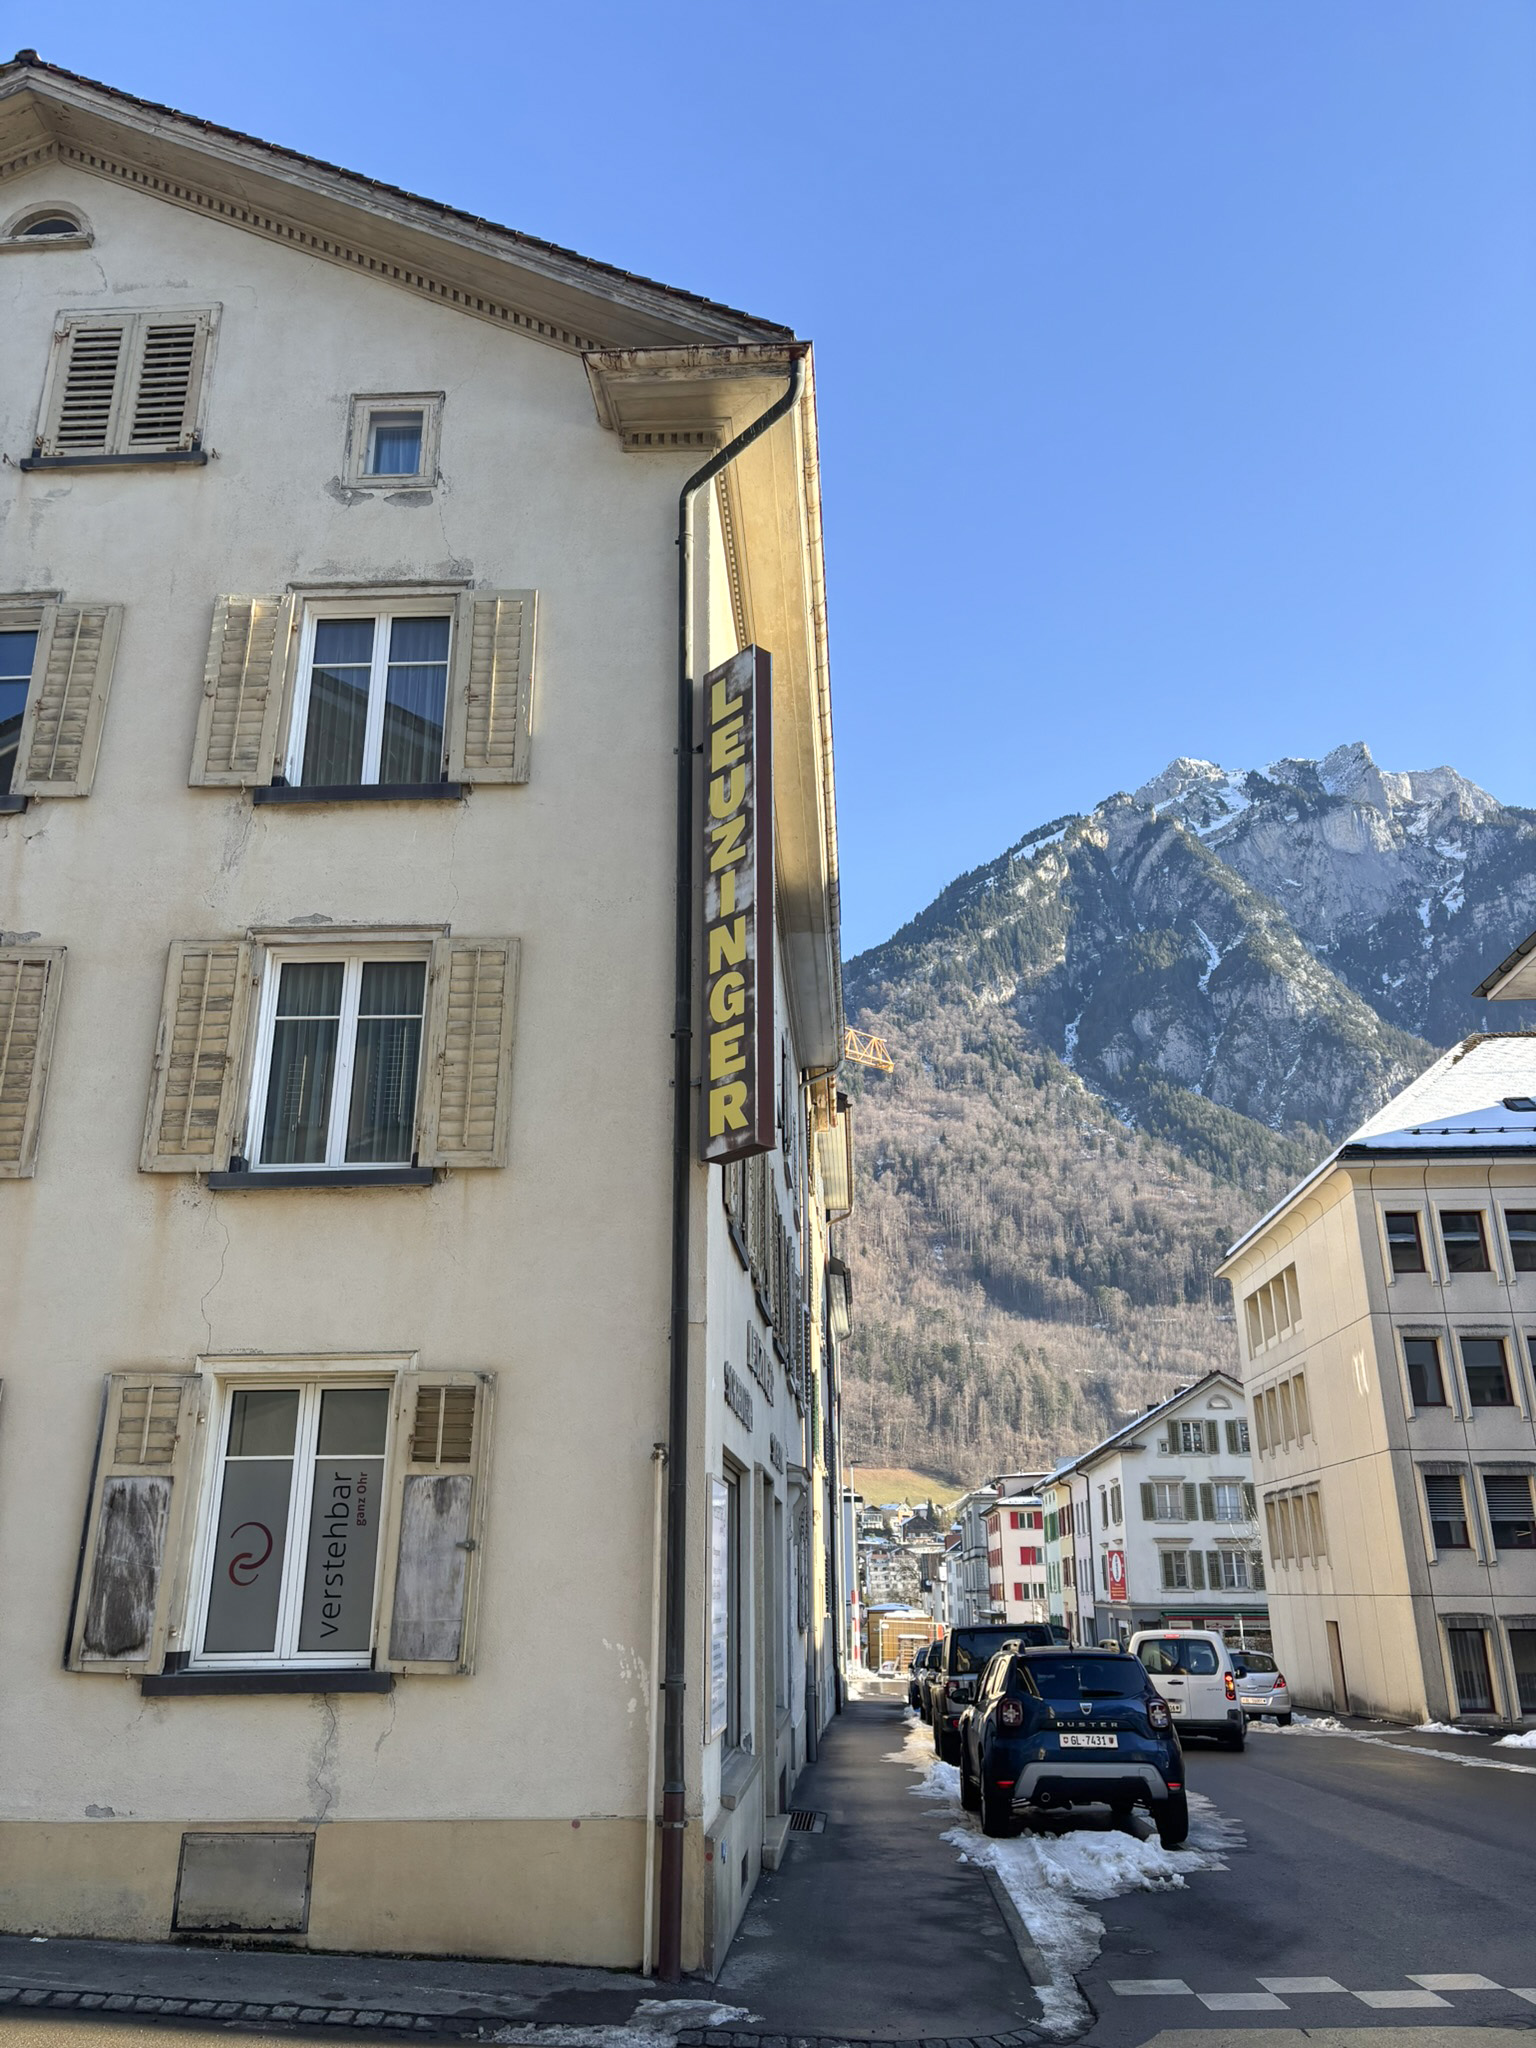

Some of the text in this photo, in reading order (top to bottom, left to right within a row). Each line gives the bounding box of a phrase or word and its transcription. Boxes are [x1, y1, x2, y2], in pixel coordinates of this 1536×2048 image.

[709, 678, 749, 1138] LEUZINGER
[319, 1471, 352, 1639] verstehbar
[356, 1471, 368, 1527] ganz Ohr
